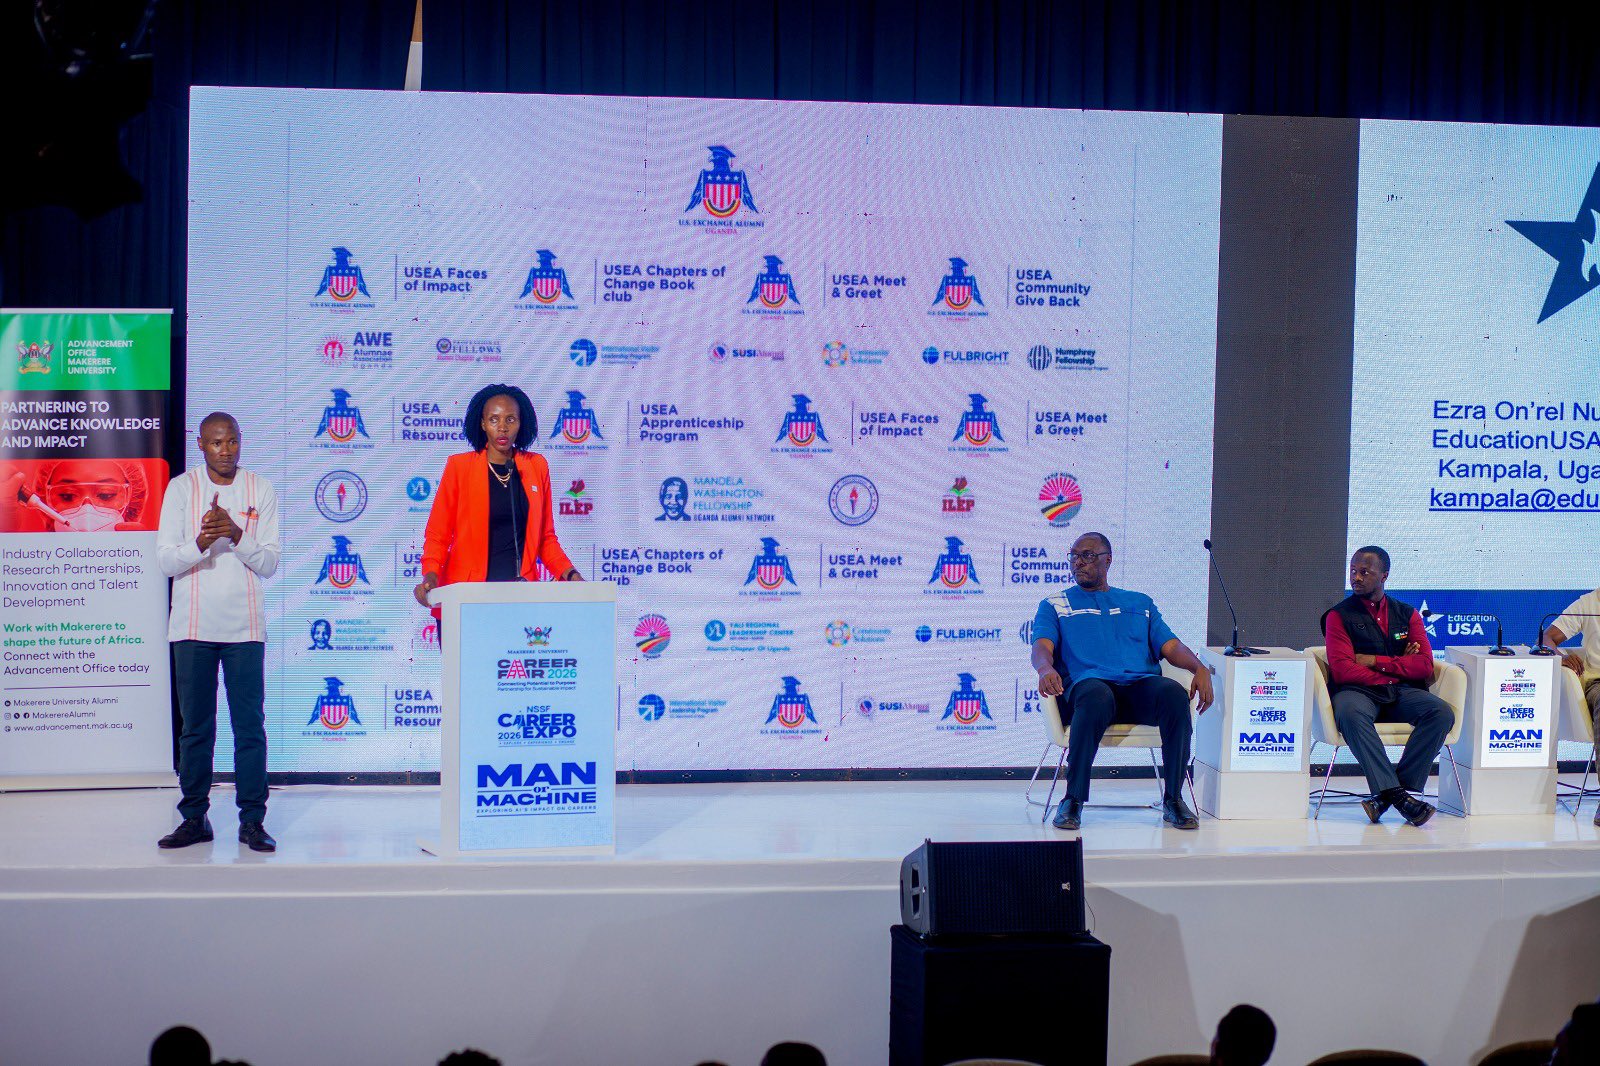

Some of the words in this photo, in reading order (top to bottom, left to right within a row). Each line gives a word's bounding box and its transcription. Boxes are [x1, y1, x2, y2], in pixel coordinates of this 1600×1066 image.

[405, 267, 442, 279] USEA
[448, 268, 487, 280] Faces
[604, 265, 641, 276] USEA
[646, 265, 707, 278] Chapters
[711, 265, 726, 277] of
[1016, 270, 1052, 281] USEA
[404, 280, 418, 290] of
[423, 280, 471, 293] Impact
[604, 278, 655, 290] Change
[660, 278, 695, 290] Book
[832, 275, 869, 286] USEA
[873, 275, 906, 287] Meet
[831, 288, 840, 298] &
[845, 288, 882, 299] Greet
[1015, 282, 1090, 296] Community
[603, 290, 632, 302] club
[1015, 295, 1044, 306] Give
[1049, 296, 1080, 307] Back
[67, 340, 134, 348] ADVANCEMENT
[353, 332, 392, 346] AWE
[67, 349, 97, 357] OFFICE
[943, 351, 1009, 361] FULBRIGHT
[1055, 348, 1096, 357] Humphrey
[67, 358, 111, 366] MAKERERE
[1055, 357, 1095, 365] Fellowship
[67, 366, 117, 375] UNIVERSITY
[1, 401, 87, 414] PARTNERING
[90, 401, 110, 413] TO
[402, 403, 440, 414] USEA
[641, 404, 678, 415] USEA
[1433, 400, 1486, 419] Ezra
[402, 415, 463, 427] Commun
[860, 412, 897, 423] USEA
[902, 413, 939, 424] Faces
[1036, 412, 1071, 423] USEA
[1076, 412, 1108, 423] Meet
[1, 418, 67, 431] ADVANCE
[70, 417, 160, 430] KNOWLEDGE
[640, 417, 743, 431] Apprenticeship
[1035, 424, 1043, 434] &
[1048, 424, 1084, 435] Greet
[641, 430, 698, 443] Program
[860, 425, 873, 436] of
[878, 425, 923, 438] Impact
[1, 436, 31, 448] AND
[35, 435, 87, 448] IMPACT
[1432, 429, 1600, 450] EducationUSA
[1438, 459, 1548, 483] Kampala,
[1558, 460, 1600, 484] Uga
[694, 477, 744, 486] MANDELA
[694, 489, 764, 498] WASHINGTON
[1430, 488, 1600, 511] kampala@edu
[560, 502, 593, 515] ILEP
[694, 501, 753, 510] FELLOWSHIP
[694, 514, 719, 522] UGANDA
[746, 514, 775, 522] NETWORK
[2, 548, 52, 560] Industry
[55, 547, 143, 559] Collaboration,
[602, 548, 639, 560] USEA
[644, 549, 704, 562] Chapters
[709, 549, 724, 560] of
[1011, 548, 1047, 558] USEA
[828, 555, 865, 566] USEA
[870, 555, 902, 566] Meet
[1011, 560, 1069, 571] Commun
[3, 564, 60, 576] Research
[63, 563, 144, 576] Partnerships,
[403, 568, 417, 577] of
[602, 562, 653, 575] Change
[658, 563, 692, 573] Book
[828, 569, 837, 578] &
[842, 568, 878, 579] Greet
[1011, 573, 1040, 584] Give
[1044, 573, 1075, 583] Back
[3, 580, 68, 592] Innovation
[71, 579, 95, 590] and
[99, 579, 138, 590] Talent
[3, 596, 86, 609] Development
[1448, 613, 1496, 622] Education
[3, 623, 32, 633] Work
[35, 622, 58, 632] with
[60, 622, 112, 632] Makerere
[115, 622, 126, 631] to
[1448, 623, 1485, 635] USA
[936, 629, 1002, 639] FULBRIGHT
[3, 637, 36, 648] shape
[38, 637, 56, 646] the
[58, 636, 91, 646] future
[94, 635, 106, 645] of
[108, 635, 145, 645] Africa.
[3, 651, 50, 661] Connect
[53, 650, 76, 660] with
[78, 650, 96, 660] the
[3, 664, 80, 675] Advancement
[82, 663, 116, 674] Office
[118, 663, 150, 674] today
[497, 658, 577, 669] CAREER
[497, 669, 545, 679] FAIR
[548, 669, 577, 679] 2026
[394, 690, 433, 701] USEA
[13, 699, 50, 707] Makerere
[52, 698, 89, 706] University
[91, 697, 119, 705] Alumni
[1023, 702, 1031, 712] &
[32, 711, 96, 719] MakerereAlumni
[498, 713, 576, 728] CAREER
[13, 722, 133, 732] www.advancement.mak.ac.ug
[394, 716, 441, 727] Resour
[498, 732, 521, 740] 2026
[523, 725, 577, 739] EXPO
[1240, 733, 1294, 743] MAN
[1490, 729, 1542, 740] MAN
[477, 762, 596, 788] MAN
[477, 792, 597, 807] MACHINE
